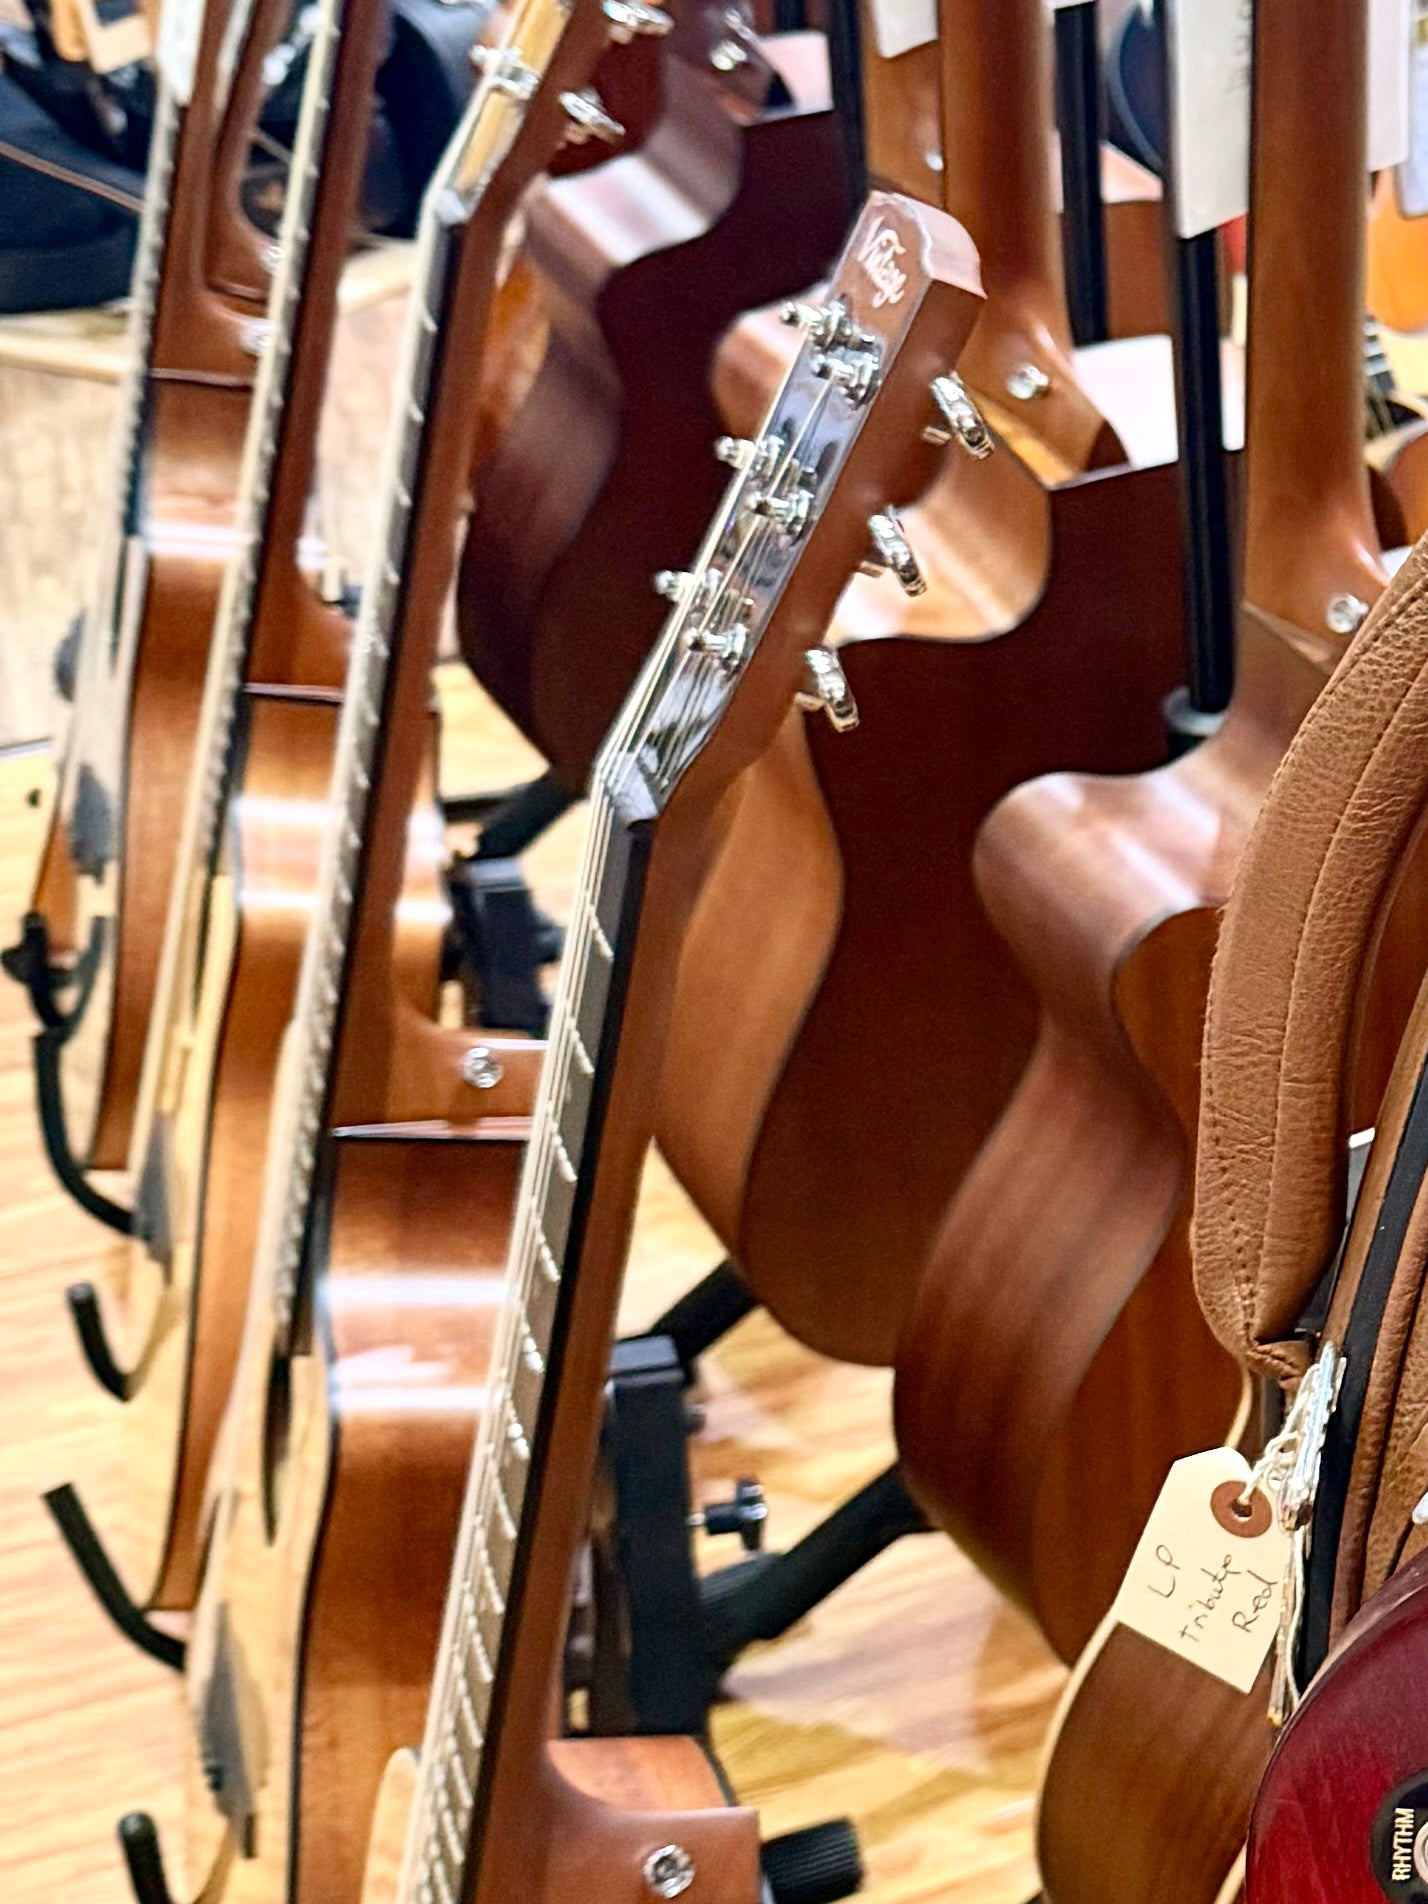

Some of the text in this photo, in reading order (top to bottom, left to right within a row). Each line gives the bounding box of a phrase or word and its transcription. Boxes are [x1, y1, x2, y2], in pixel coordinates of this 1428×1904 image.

[1147, 1544, 1181, 1599] LP
[1179, 1554, 1242, 1643] Tribute
[1231, 1569, 1279, 1634] Red
[1391, 1807, 1415, 1883] RHYTHM
